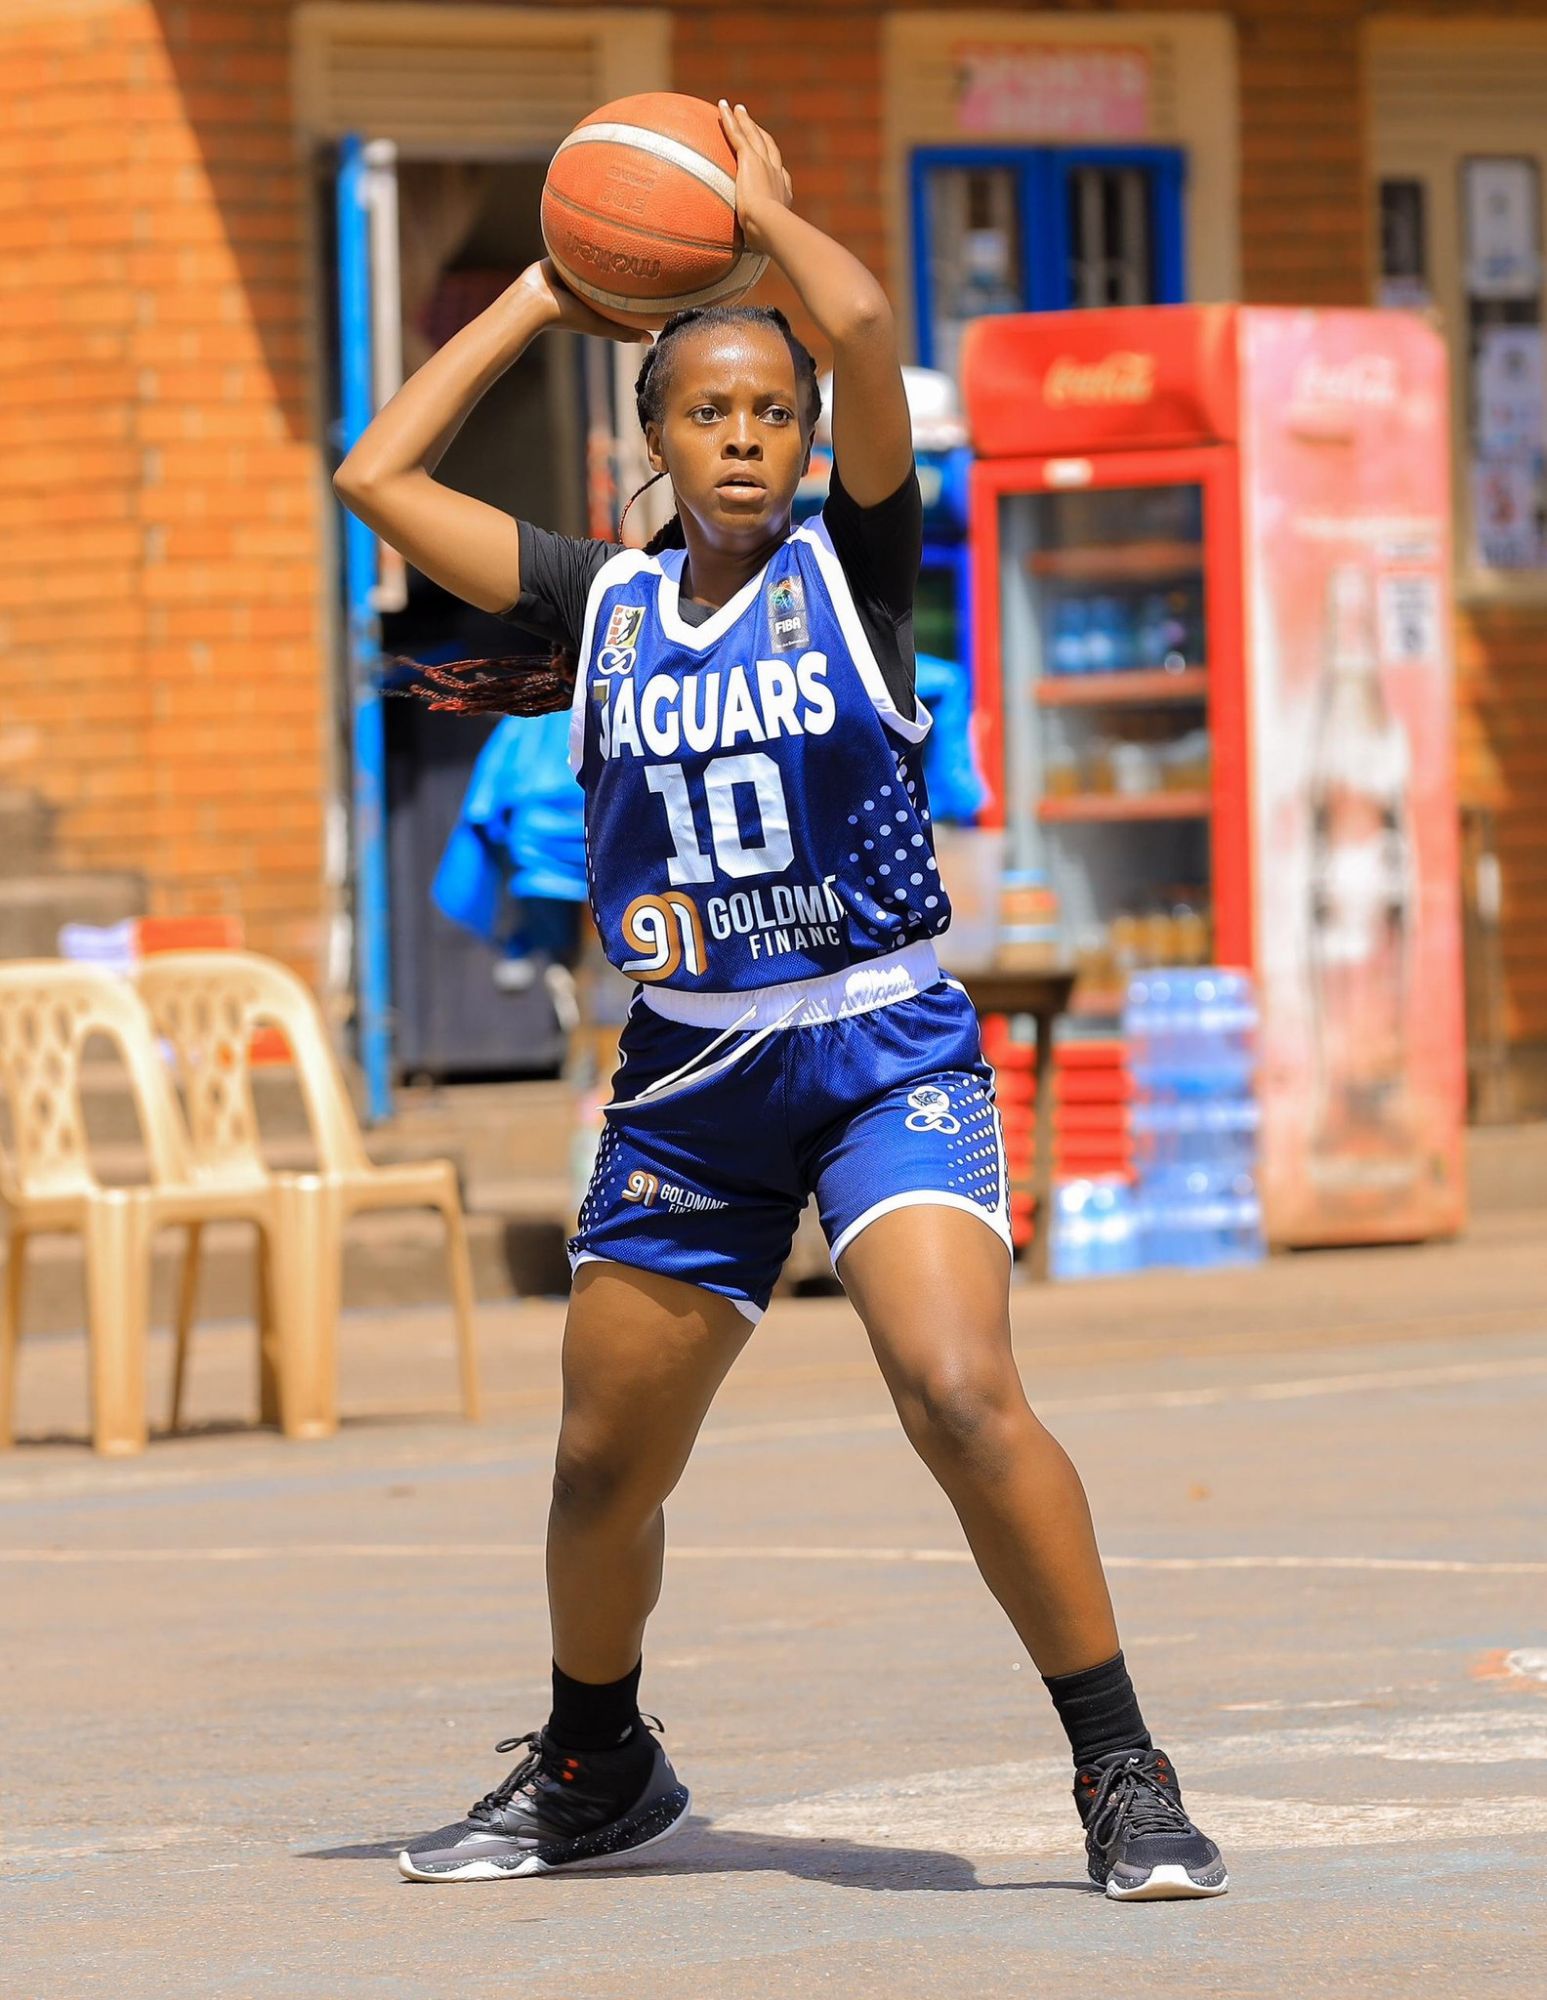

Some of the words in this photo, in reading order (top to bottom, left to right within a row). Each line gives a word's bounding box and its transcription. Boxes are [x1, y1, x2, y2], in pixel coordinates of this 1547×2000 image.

[775, 616, 802, 635] FIBA
[593, 651, 836, 761] JAGUARS
[643, 752, 795, 886] 10
